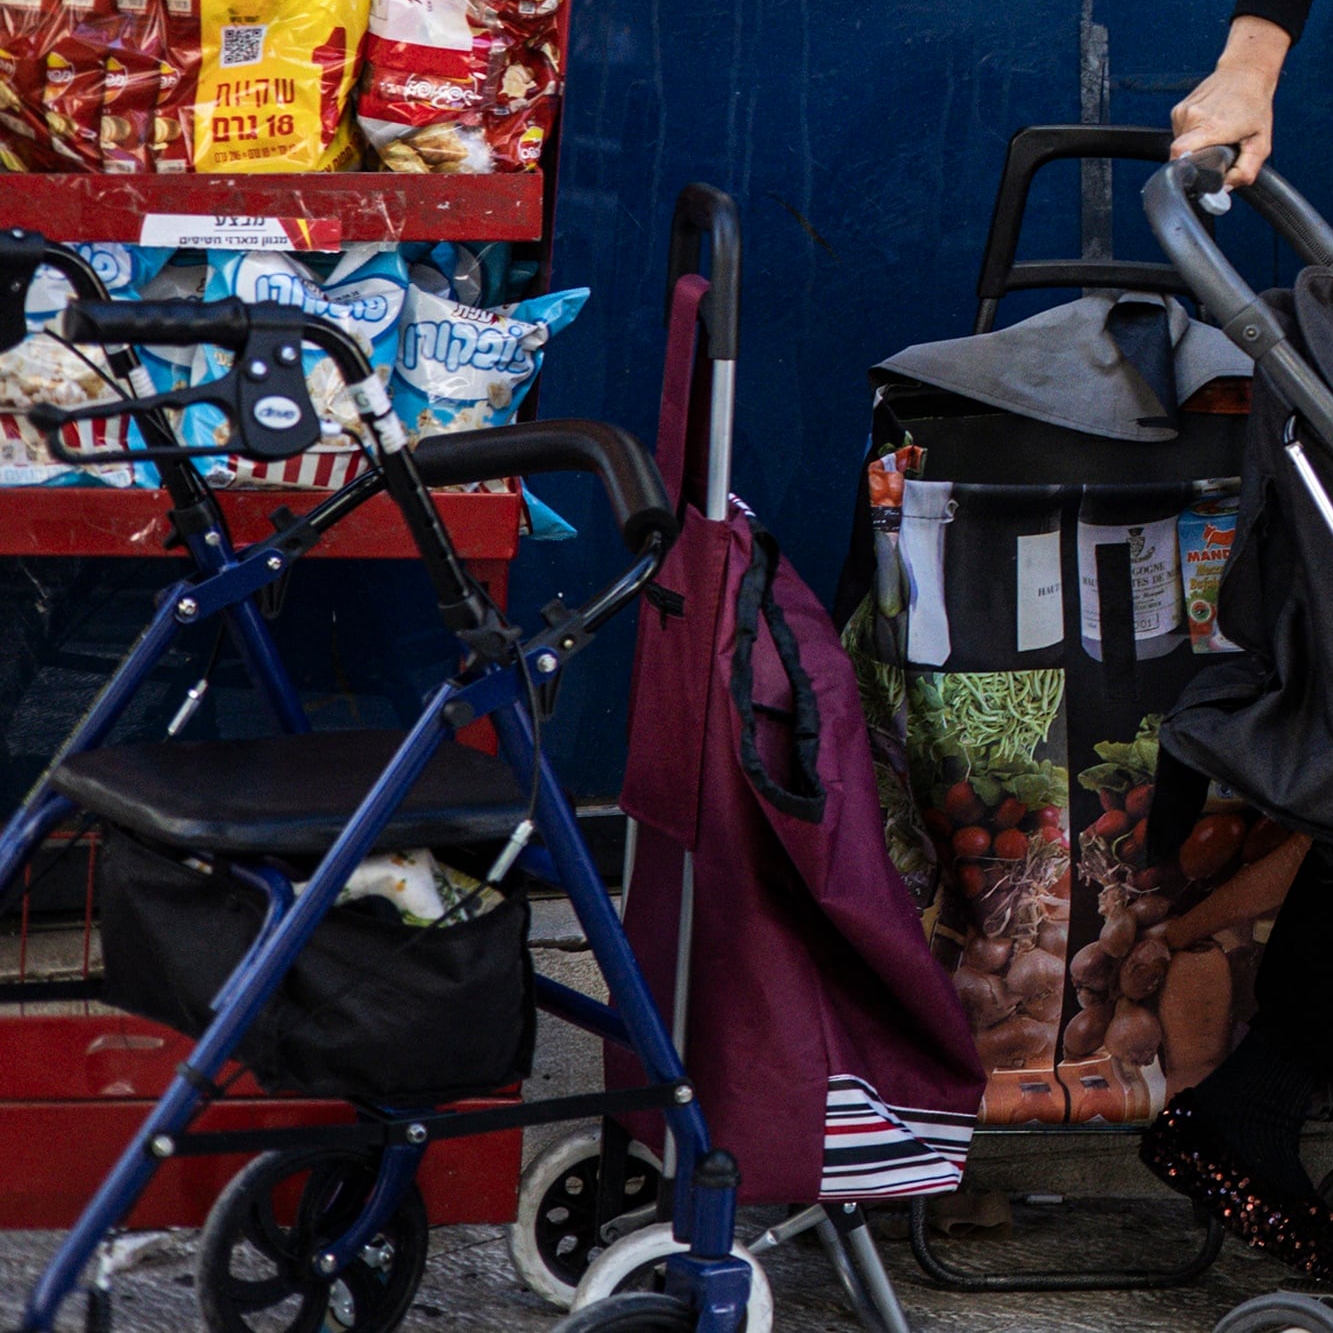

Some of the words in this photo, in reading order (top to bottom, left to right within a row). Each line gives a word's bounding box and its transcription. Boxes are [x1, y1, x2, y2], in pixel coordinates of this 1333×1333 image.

[215, 78, 295, 108] שקיות
[212, 115, 258, 143] גרם
[266, 114, 294, 138] 18
[214, 216, 267, 227] מבצע
[178, 235, 222, 247] חטיפים
[224, 235, 257, 246] מארזי
[258, 236, 289, 247] מגוון
[1187, 549, 1232, 565] MAND
[1037, 582, 1061, 598] HAUT
